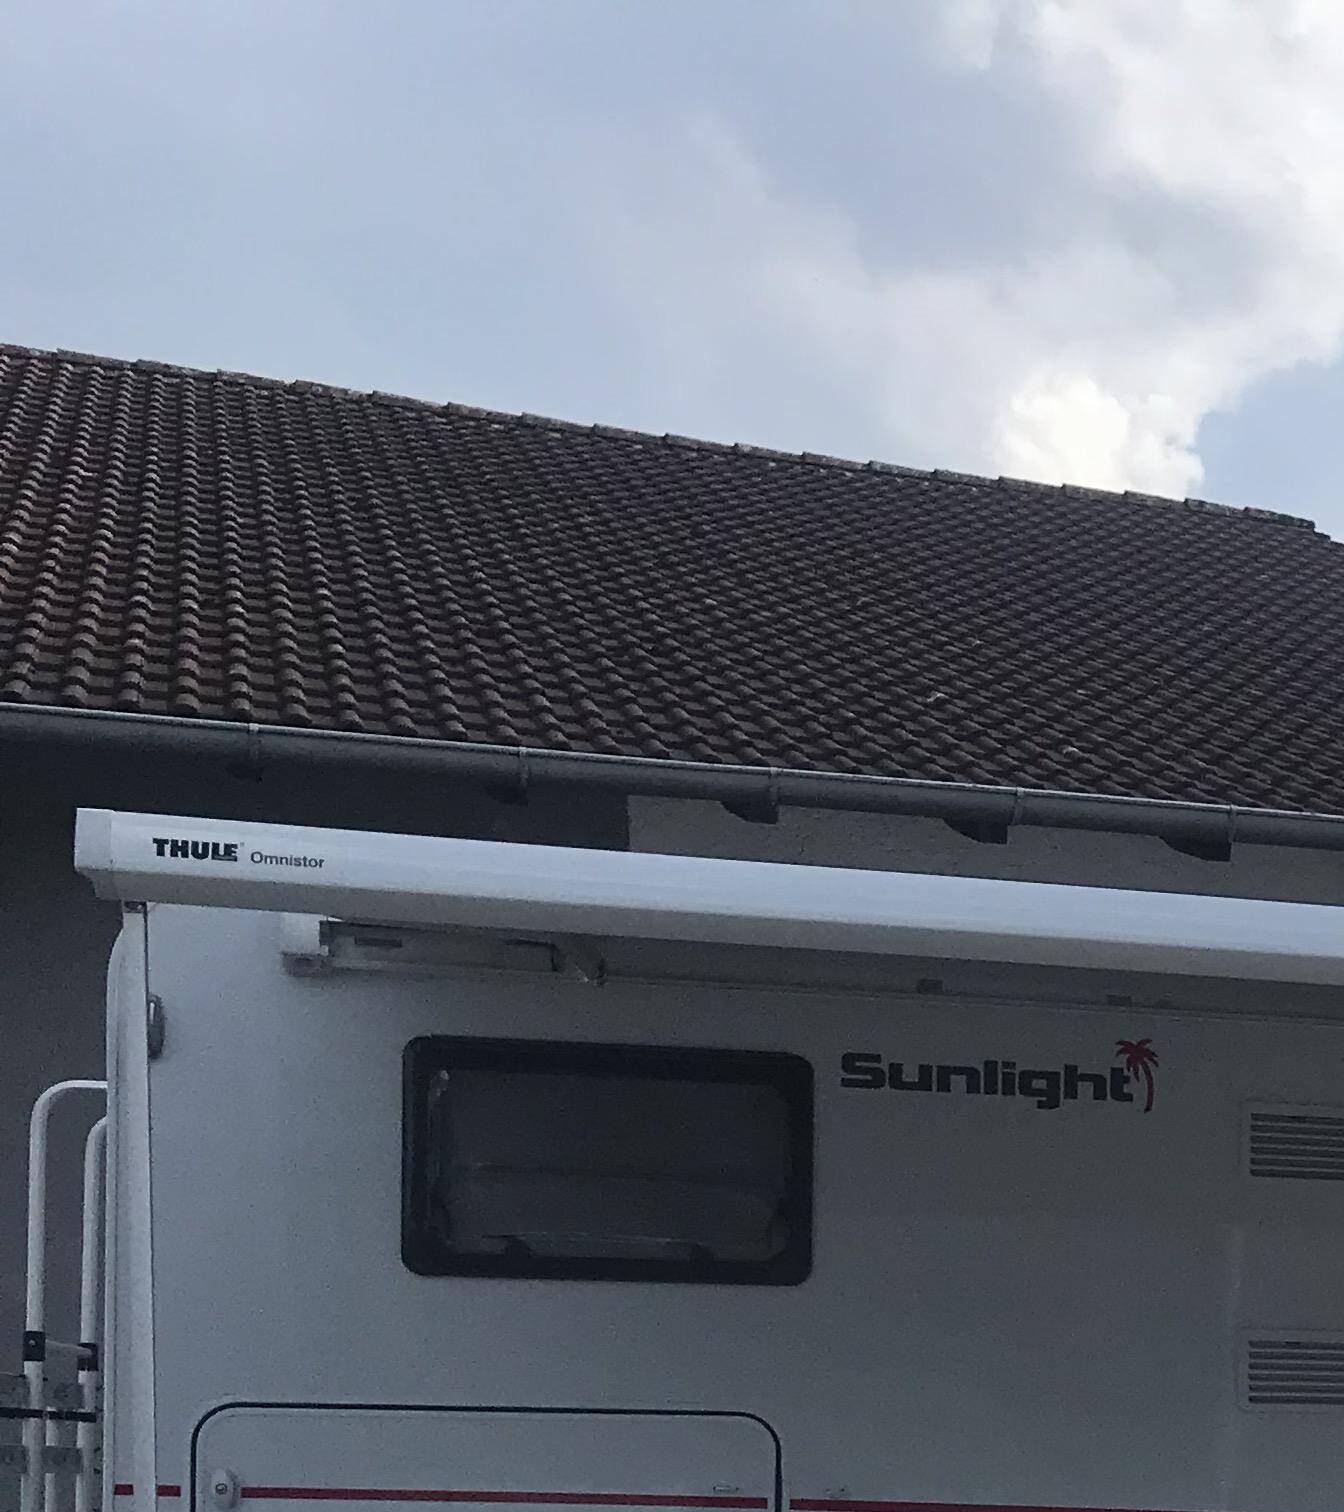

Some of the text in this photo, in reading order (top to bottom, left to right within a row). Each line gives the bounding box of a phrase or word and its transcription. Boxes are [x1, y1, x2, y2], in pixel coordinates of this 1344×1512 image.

[152, 837, 325, 868] THULE Omnistor
[840, 1051, 1134, 1110] Sunlight
